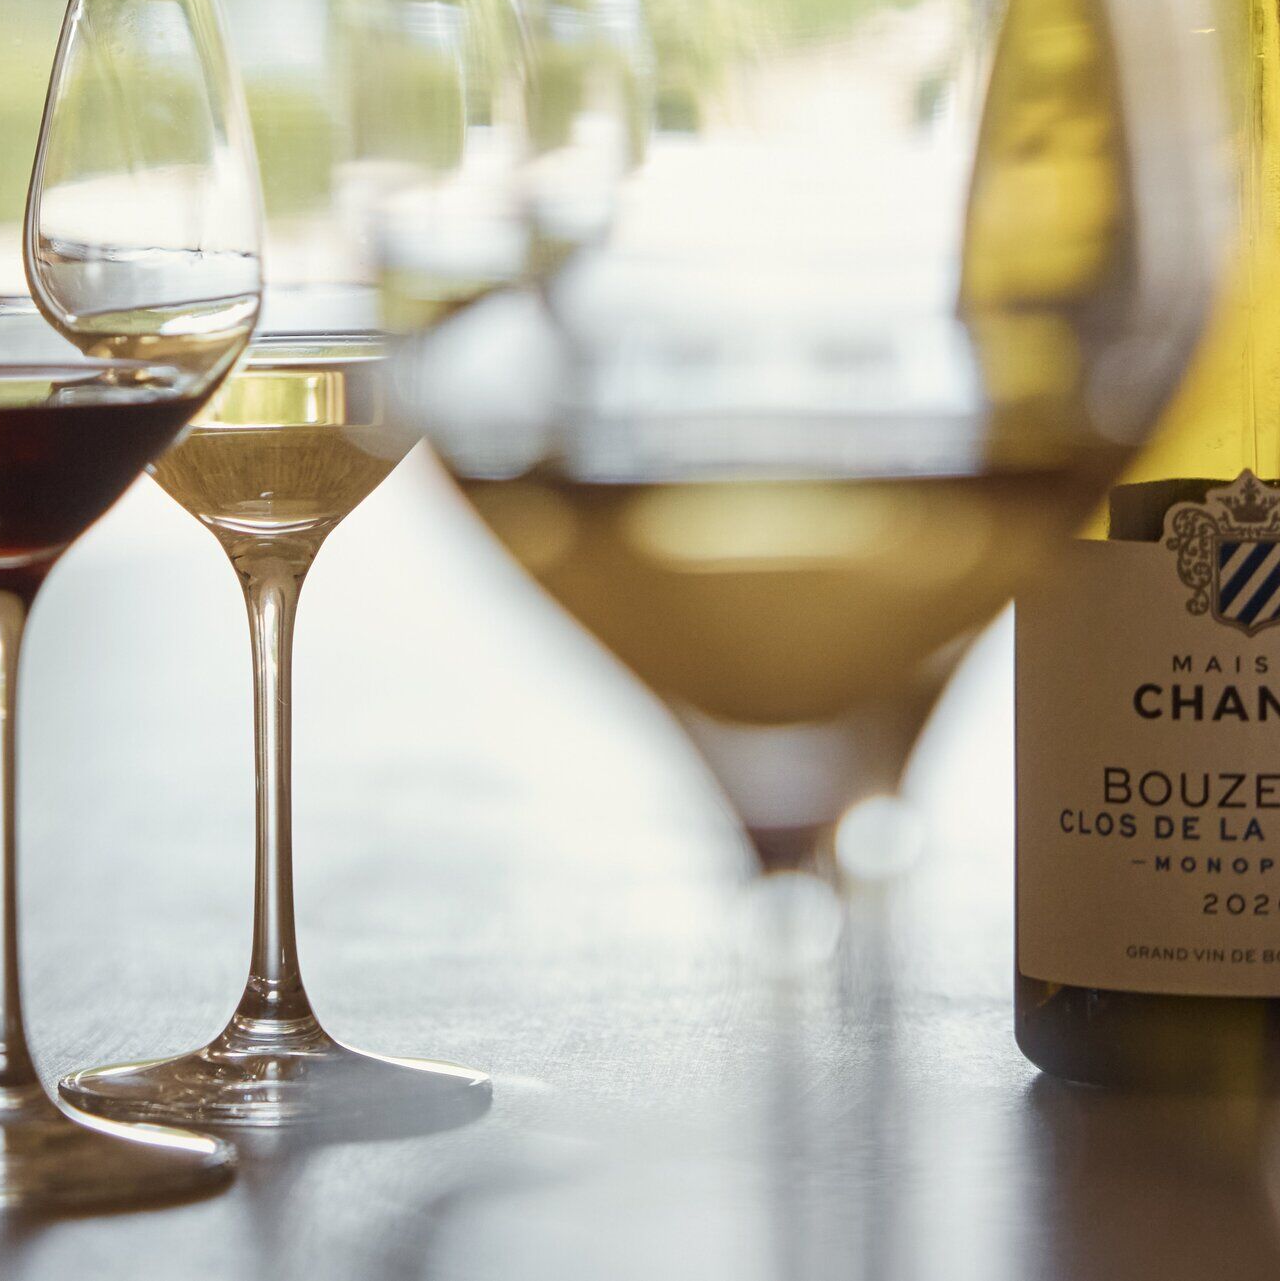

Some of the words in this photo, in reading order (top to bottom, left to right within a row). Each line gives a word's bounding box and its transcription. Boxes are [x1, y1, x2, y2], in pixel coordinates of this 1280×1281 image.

[1060, 809, 1137, 838] CLOS
[1155, 815, 1200, 840] DE
[1220, 818, 1265, 841] LA
[1126, 945, 1188, 961] GRAND
[1193, 949, 1225, 962] VIN
[1231, 949, 1255, 963] DE
